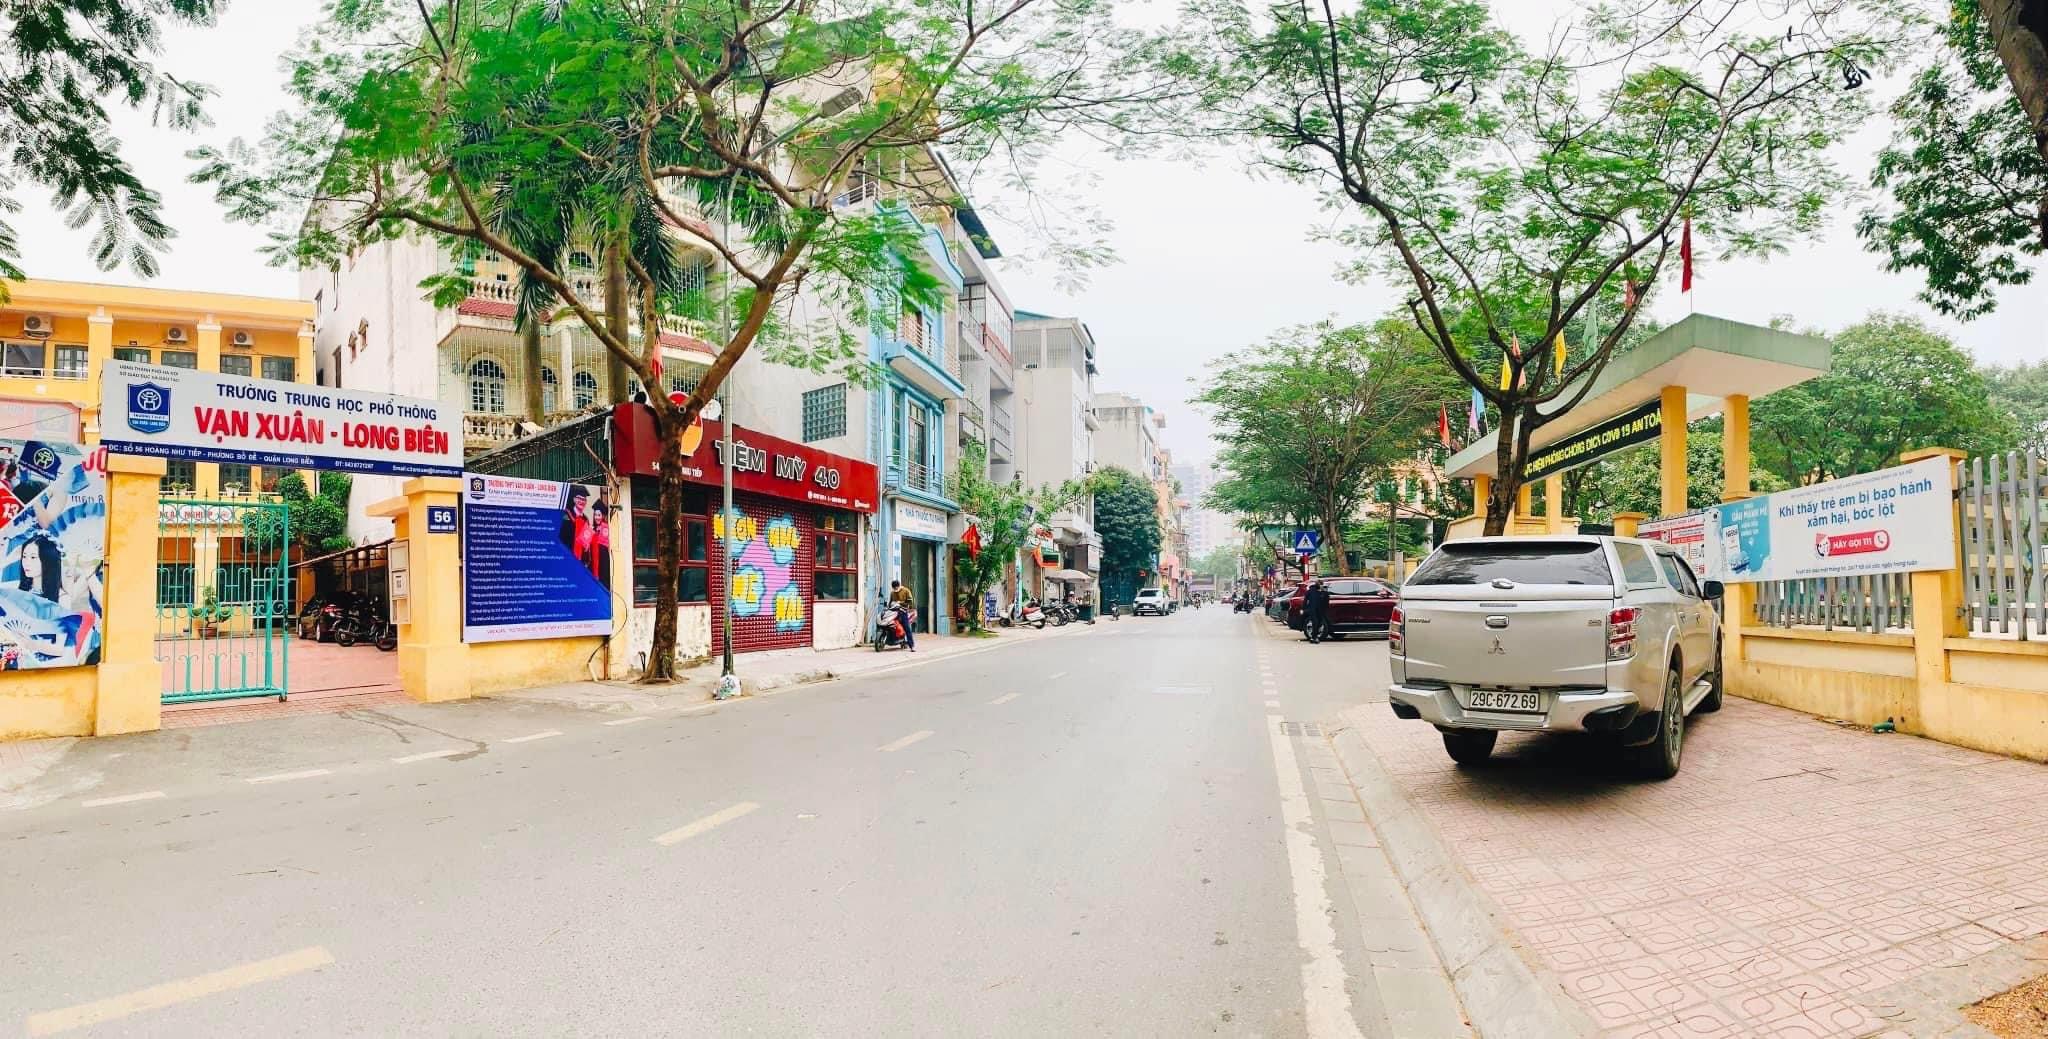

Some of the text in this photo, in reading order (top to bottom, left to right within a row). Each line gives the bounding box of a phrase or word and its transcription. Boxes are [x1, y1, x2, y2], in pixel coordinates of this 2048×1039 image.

[217, 383, 437, 421] TRƯỜNG TRUNG HỌC PHỔ THÔNG
[194, 406, 248, 443] VẠN
[256, 410, 324, 445] XUÂN
[343, 422, 400, 451] LONG
[404, 425, 449, 454] BIÊN
[1622, 423, 1630, 437] 19
[1779, 506, 1793, 518] Khi
[1797, 502, 1818, 515] thấy
[1839, 496, 1855, 507] em
[1859, 491, 1870, 506] bị
[1874, 486, 1896, 502] bạo
[434, 511, 451, 523] 56
[1849, 538, 1862, 549] GỌI
